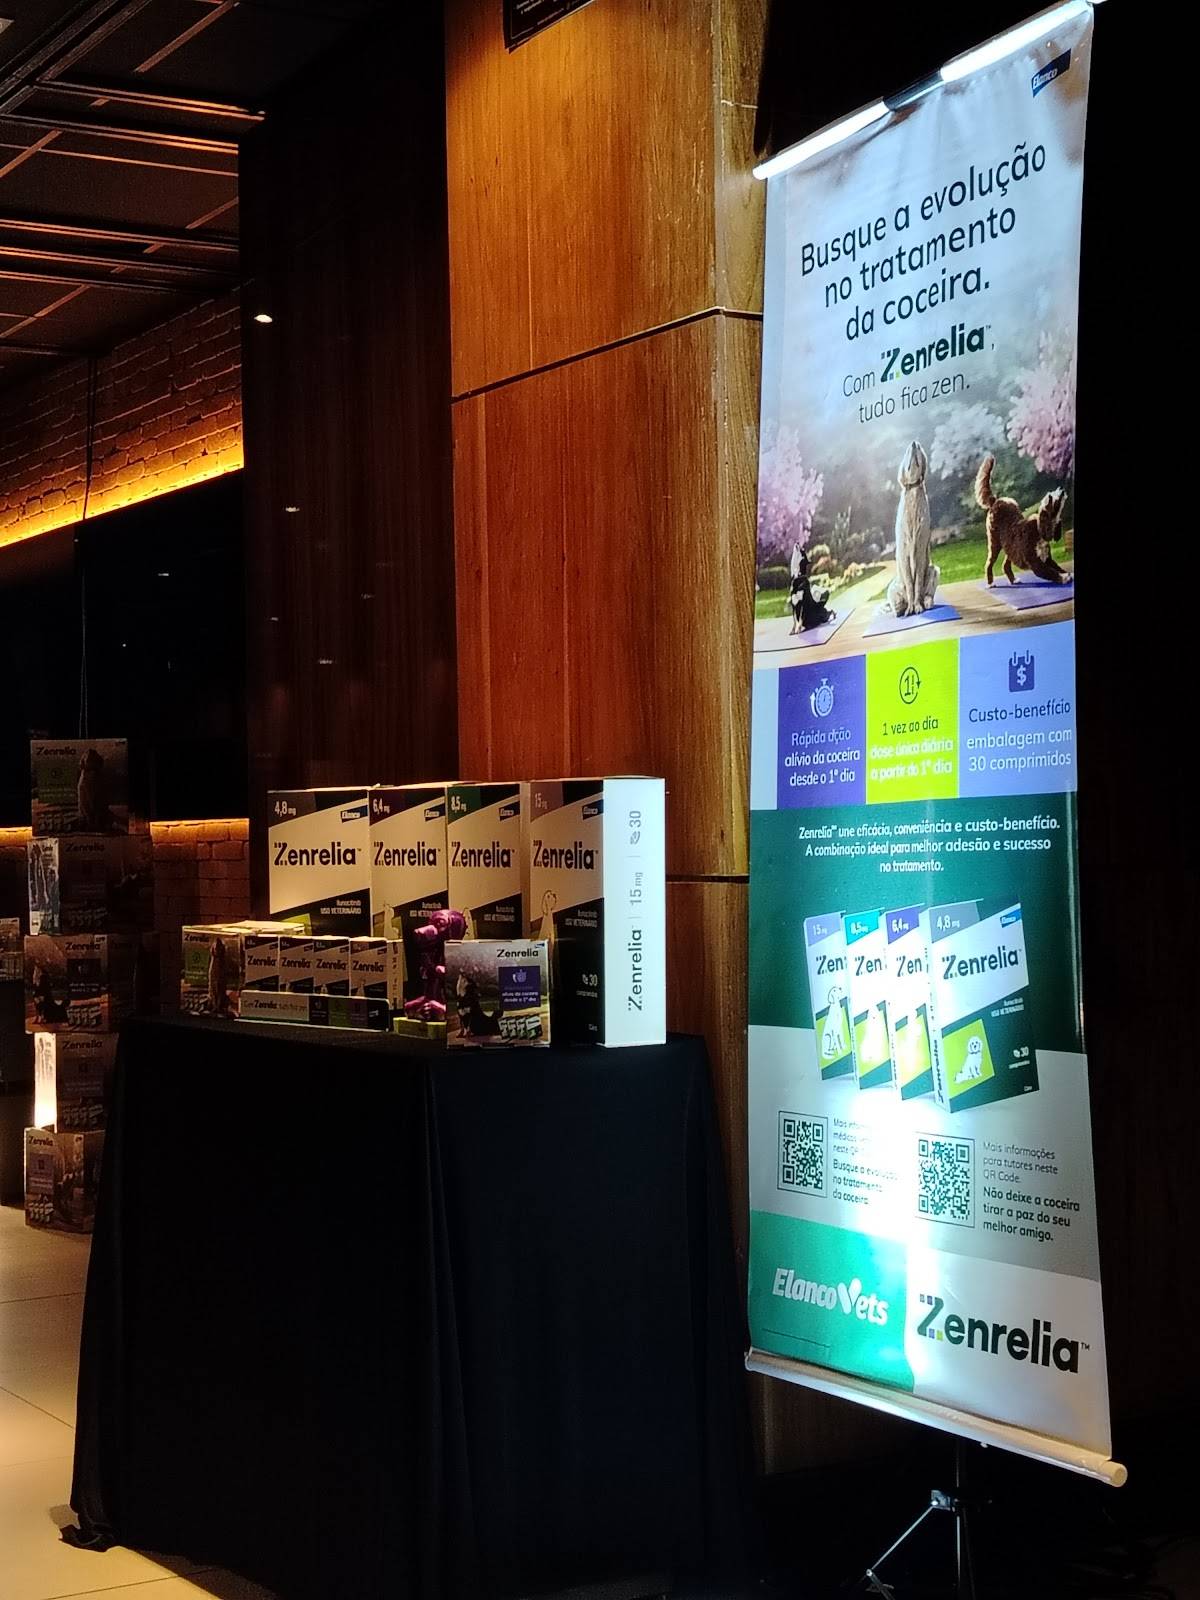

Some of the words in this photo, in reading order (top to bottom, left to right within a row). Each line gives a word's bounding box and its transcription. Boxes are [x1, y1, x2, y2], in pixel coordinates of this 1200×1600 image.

[801, 216, 886, 277] Busque
[894, 204, 910, 232] a
[920, 141, 1046, 222] evolução
[825, 275, 851, 308] no
[860, 207, 1016, 291] tratamento
[846, 305, 875, 341] da
[882, 265, 990, 325] coceira.
[843, 369, 876, 397] Com
[858, 396, 896, 424] tudo
[901, 386, 928, 411] fica
[932, 372, 970, 400] zen.
[969, 698, 1071, 722] Custo-benefício
[883, 723, 888, 735] 1
[891, 722, 906, 734] vez
[908, 721, 920, 732] ao
[923, 716, 939, 730] dia
[791, 730, 826, 748] Rápida
[828, 729, 851, 743] ação
[967, 730, 1045, 749] embalagem
[1048, 729, 1072, 743] com
[785, 749, 811, 767] alívio
[813, 750, 825, 765] da
[827, 747, 860, 764] coceira
[969, 756, 986, 771] 30
[990, 751, 1072, 772] comprimidos
[790, 770, 819, 786] desde
[820, 774, 827, 785] o
[840, 767, 855, 782] dia
[274, 801, 287, 817] 4,8
[629, 810, 642, 828] 30
[838, 827, 855, 838] une
[857, 822, 892, 837] eficácia,
[894, 819, 952, 836] conveniência
[954, 821, 963, 832] e
[965, 815, 1060, 832] custo-benefício.
[805, 844, 813, 857] A
[814, 842, 866, 858] combinação
[867, 840, 889, 855] ideal
[890, 843, 910, 857] para
[912, 838, 943, 853] melhor
[945, 838, 990, 852] adesão
[993, 841, 1001, 850] e
[1003, 839, 1051, 851] sucesso
[880, 862, 891, 873] no
[892, 858, 944, 872] tratamento.
[630, 889, 642, 906] 15
[497, 948, 539, 958] Zenrelia
[627, 930, 642, 1012] Zenrelia
[984, 1142, 1002, 1152] Mais
[1004, 1144, 1055, 1160] informações
[833, 1159, 858, 1174] Busque
[984, 1158, 1002, 1167] para
[1004, 1160, 1033, 1171] tutores
[1035, 1164, 1058, 1174] neste
[984, 1169, 996, 1179] QR
[833, 1176, 842, 1185] no
[833, 1188, 842, 1199] da
[984, 1187, 1003, 1199] Não
[1006, 1189, 1032, 1204] deixe
[1034, 1197, 1042, 1205] a
[1043, 1198, 1080, 1211] coceira
[983, 1203, 1004, 1215] tirar
[1006, 1209, 1013, 1217] a
[1016, 1210, 1035, 1221] paz
[1037, 1212, 1050, 1223] do
[1052, 1216, 1071, 1227] seu
[983, 1221, 1017, 1234] melhor
[1019, 1226, 1054, 1242] amigo.
